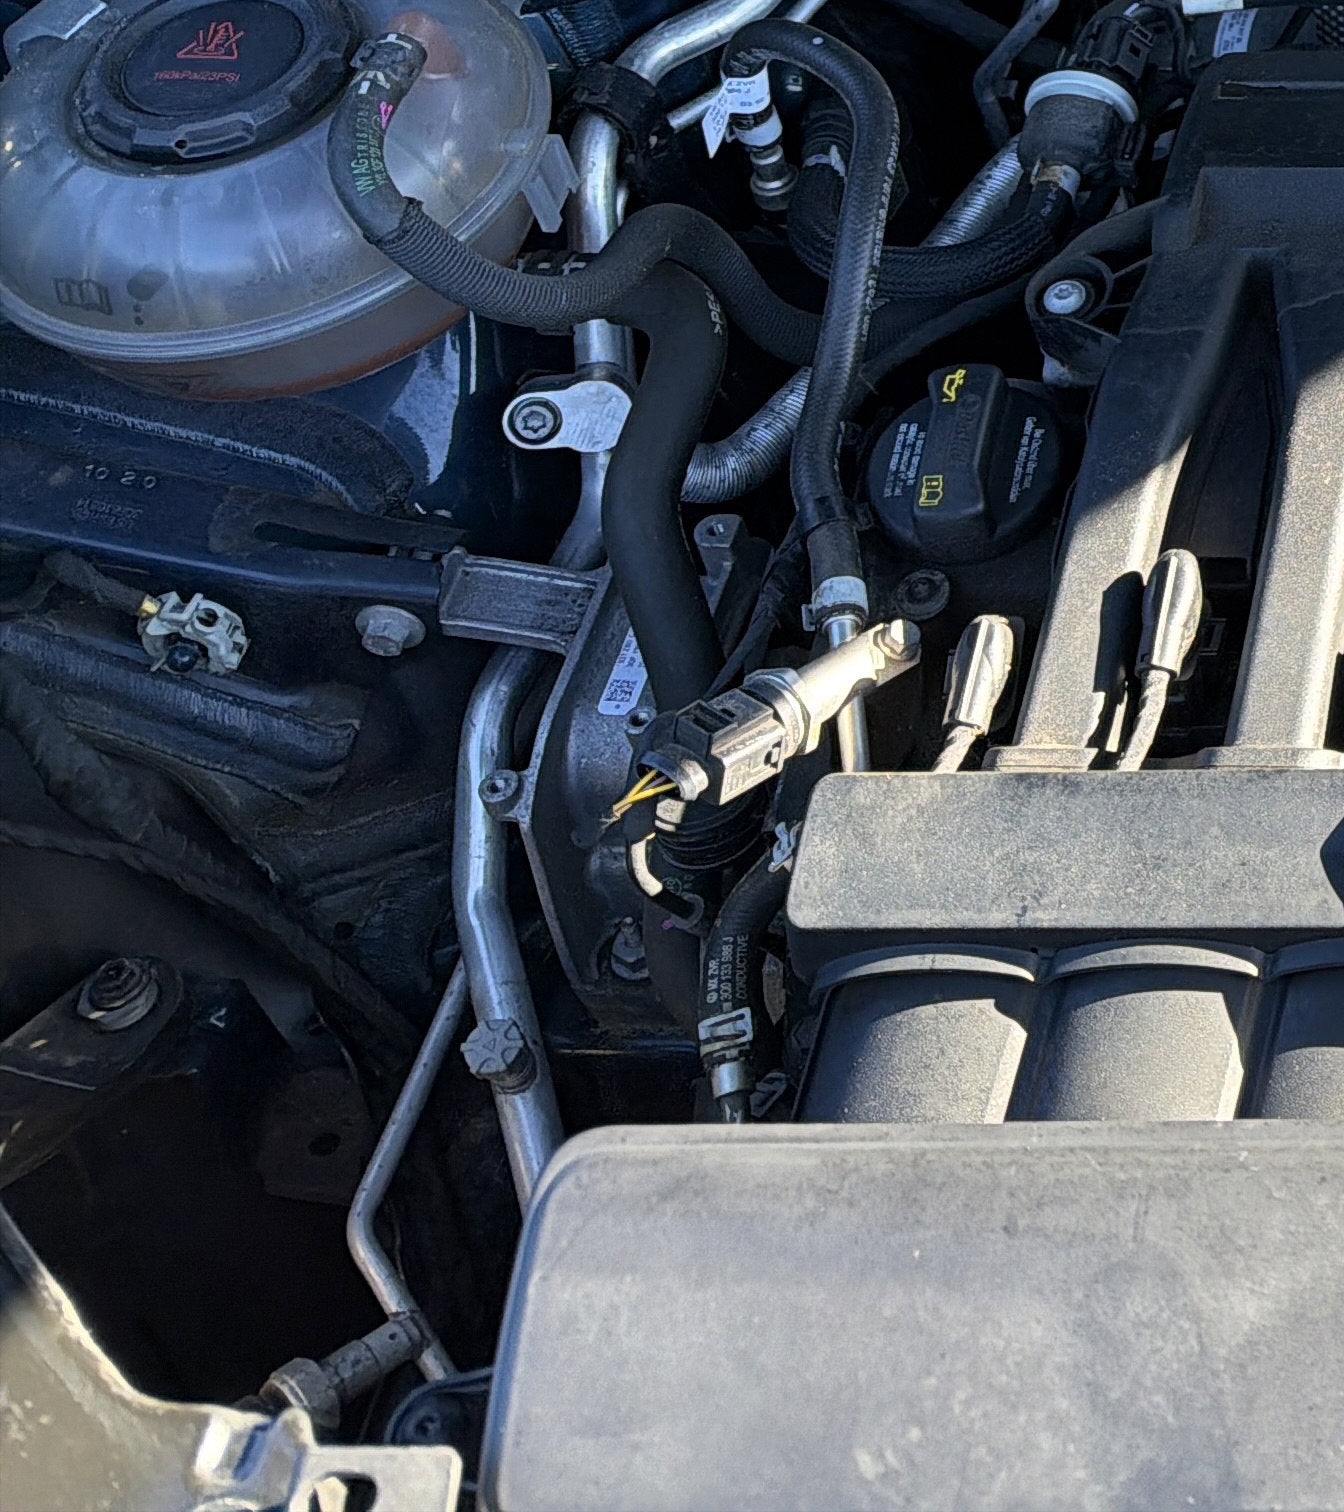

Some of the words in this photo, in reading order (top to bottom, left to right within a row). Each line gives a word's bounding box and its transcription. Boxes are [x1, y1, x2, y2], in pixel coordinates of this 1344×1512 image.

[350, 158, 370, 173] AG
[354, 175, 376, 197] VW
[734, 933, 749, 999] CONDUCTIVE
